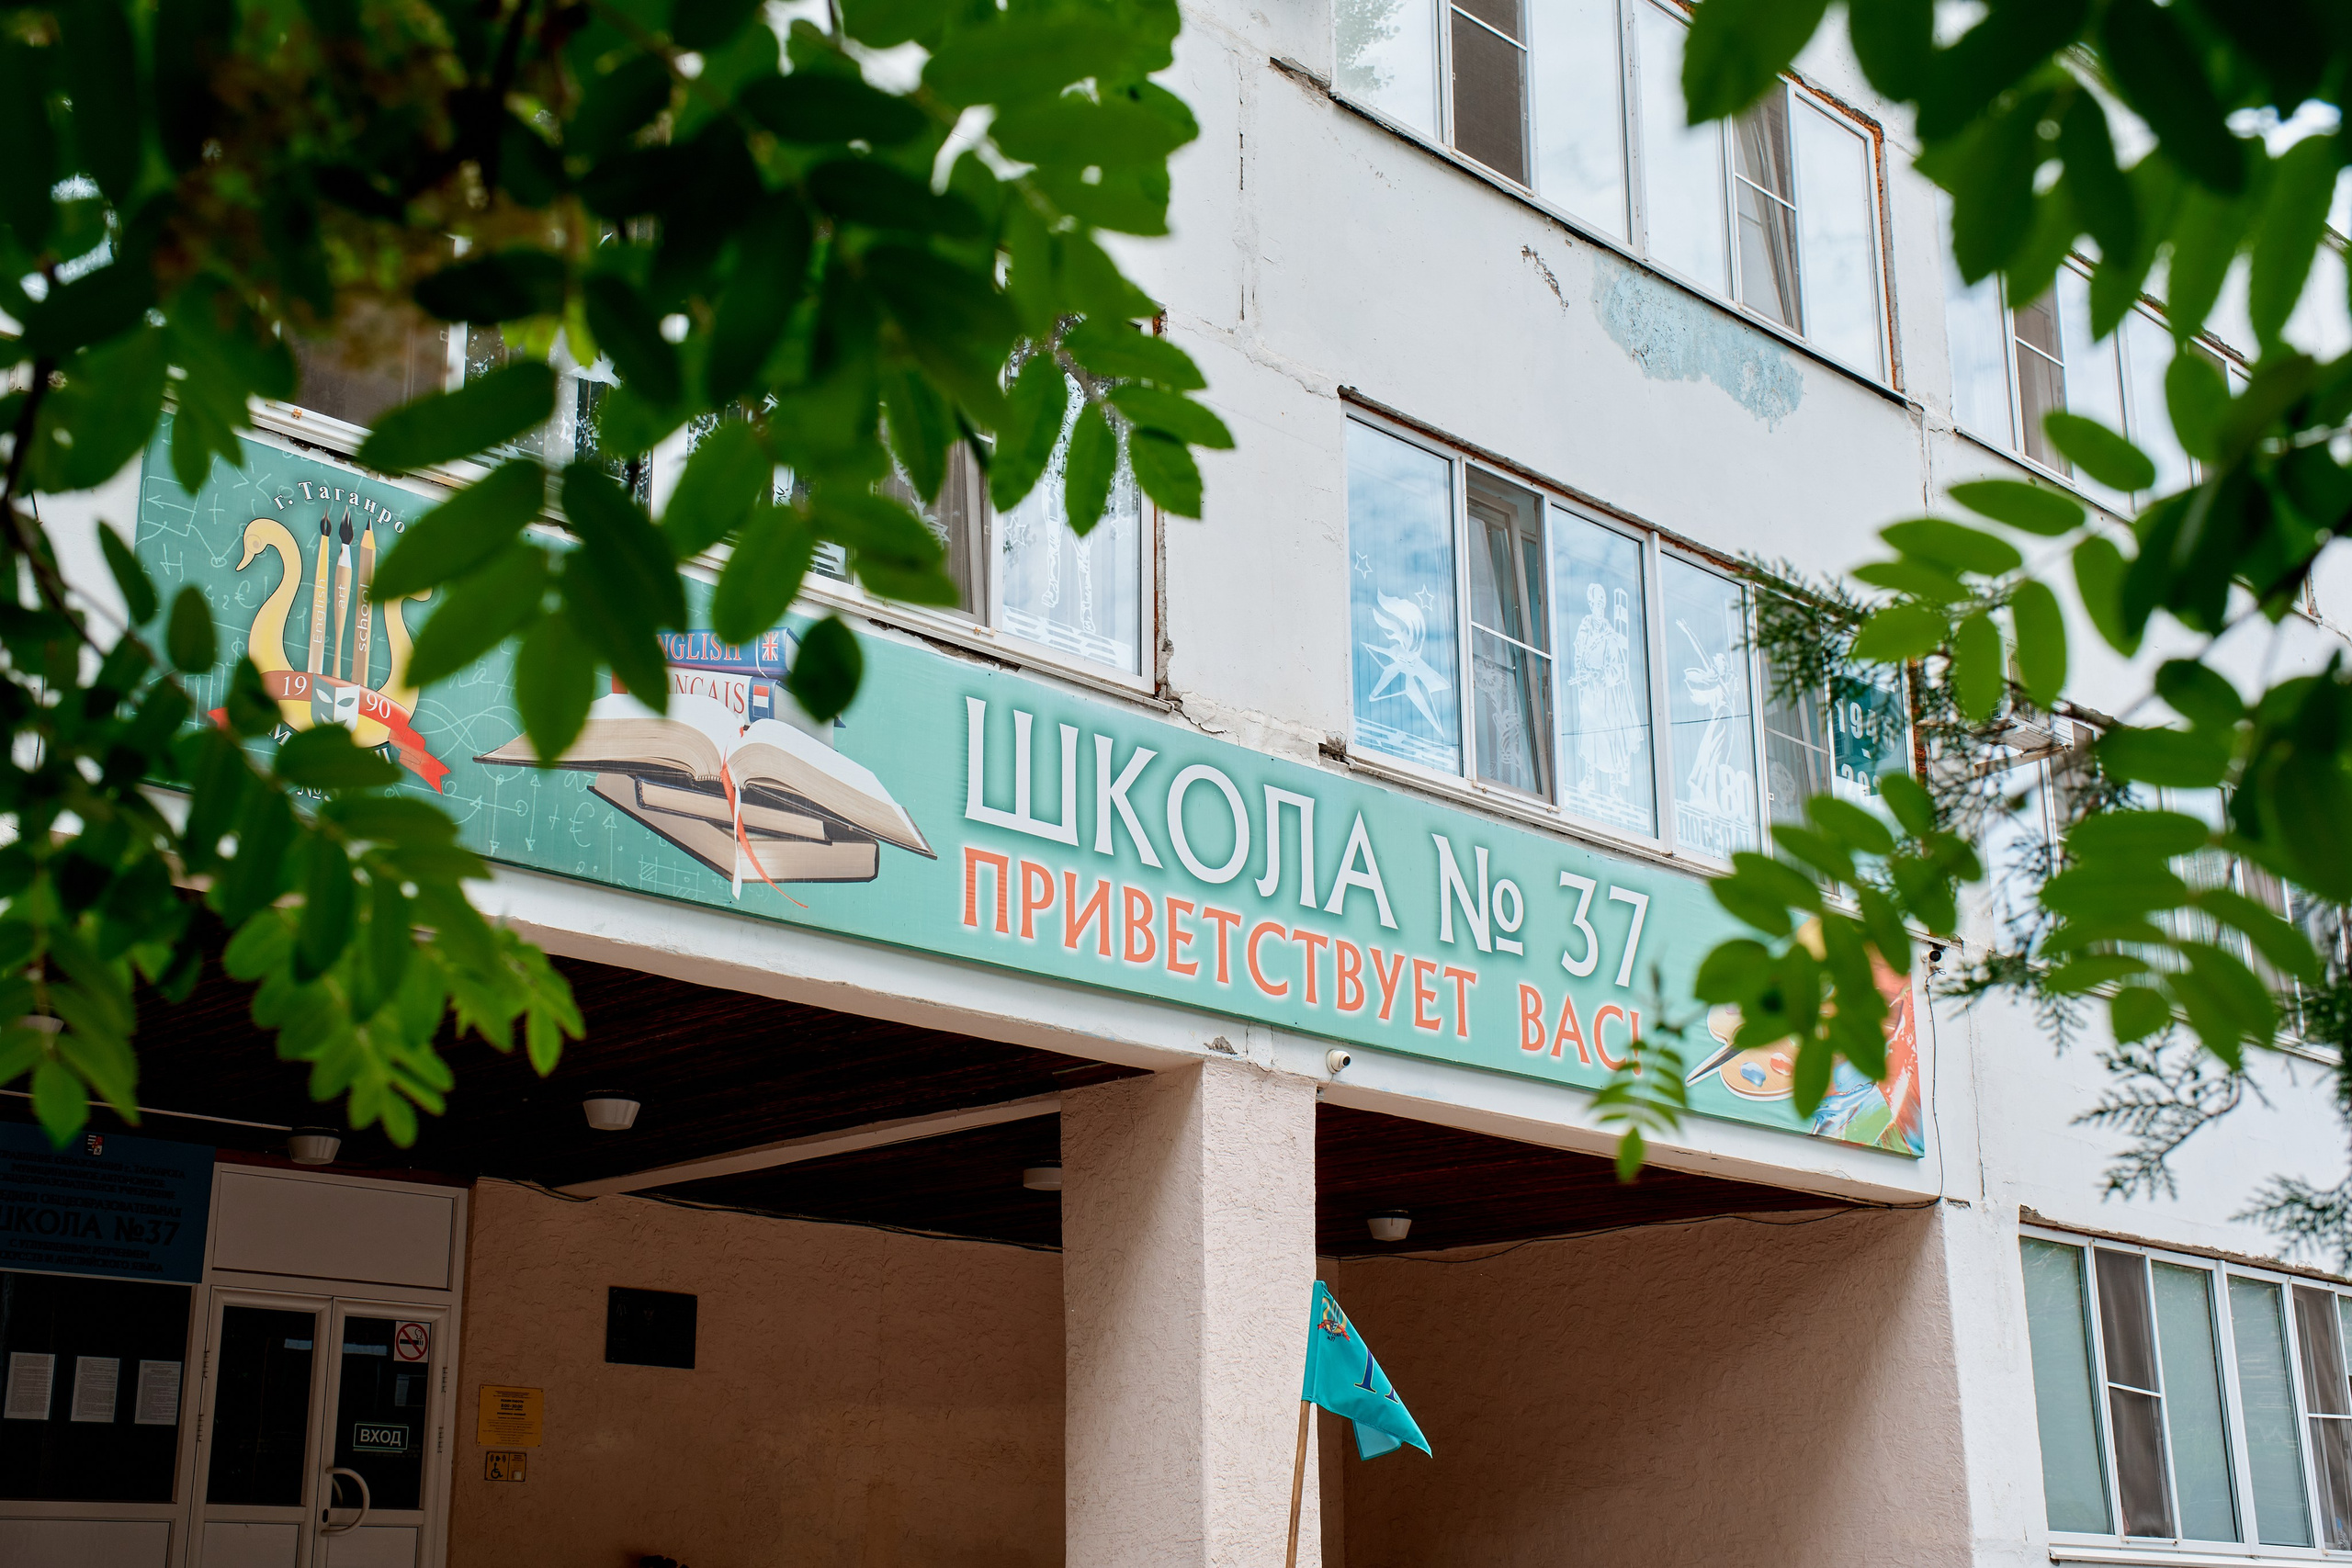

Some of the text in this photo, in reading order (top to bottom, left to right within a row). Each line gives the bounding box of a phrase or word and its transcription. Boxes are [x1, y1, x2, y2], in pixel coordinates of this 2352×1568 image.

[274, 480, 406, 535] г. Таганро
[313, 579, 326, 644] English
[337, 583, 346, 609] art
[356, 583, 370, 652] school
[656, 633, 742, 661] NGLISH
[282, 675, 390, 719] 19 90
[964, 696, 1651, 987] ШКОЛА № 37
[963, 847, 1641, 1074] ПРИВЕТСТВУЕТ ВАС!
[359, 1428, 401, 1447] ВХОД
